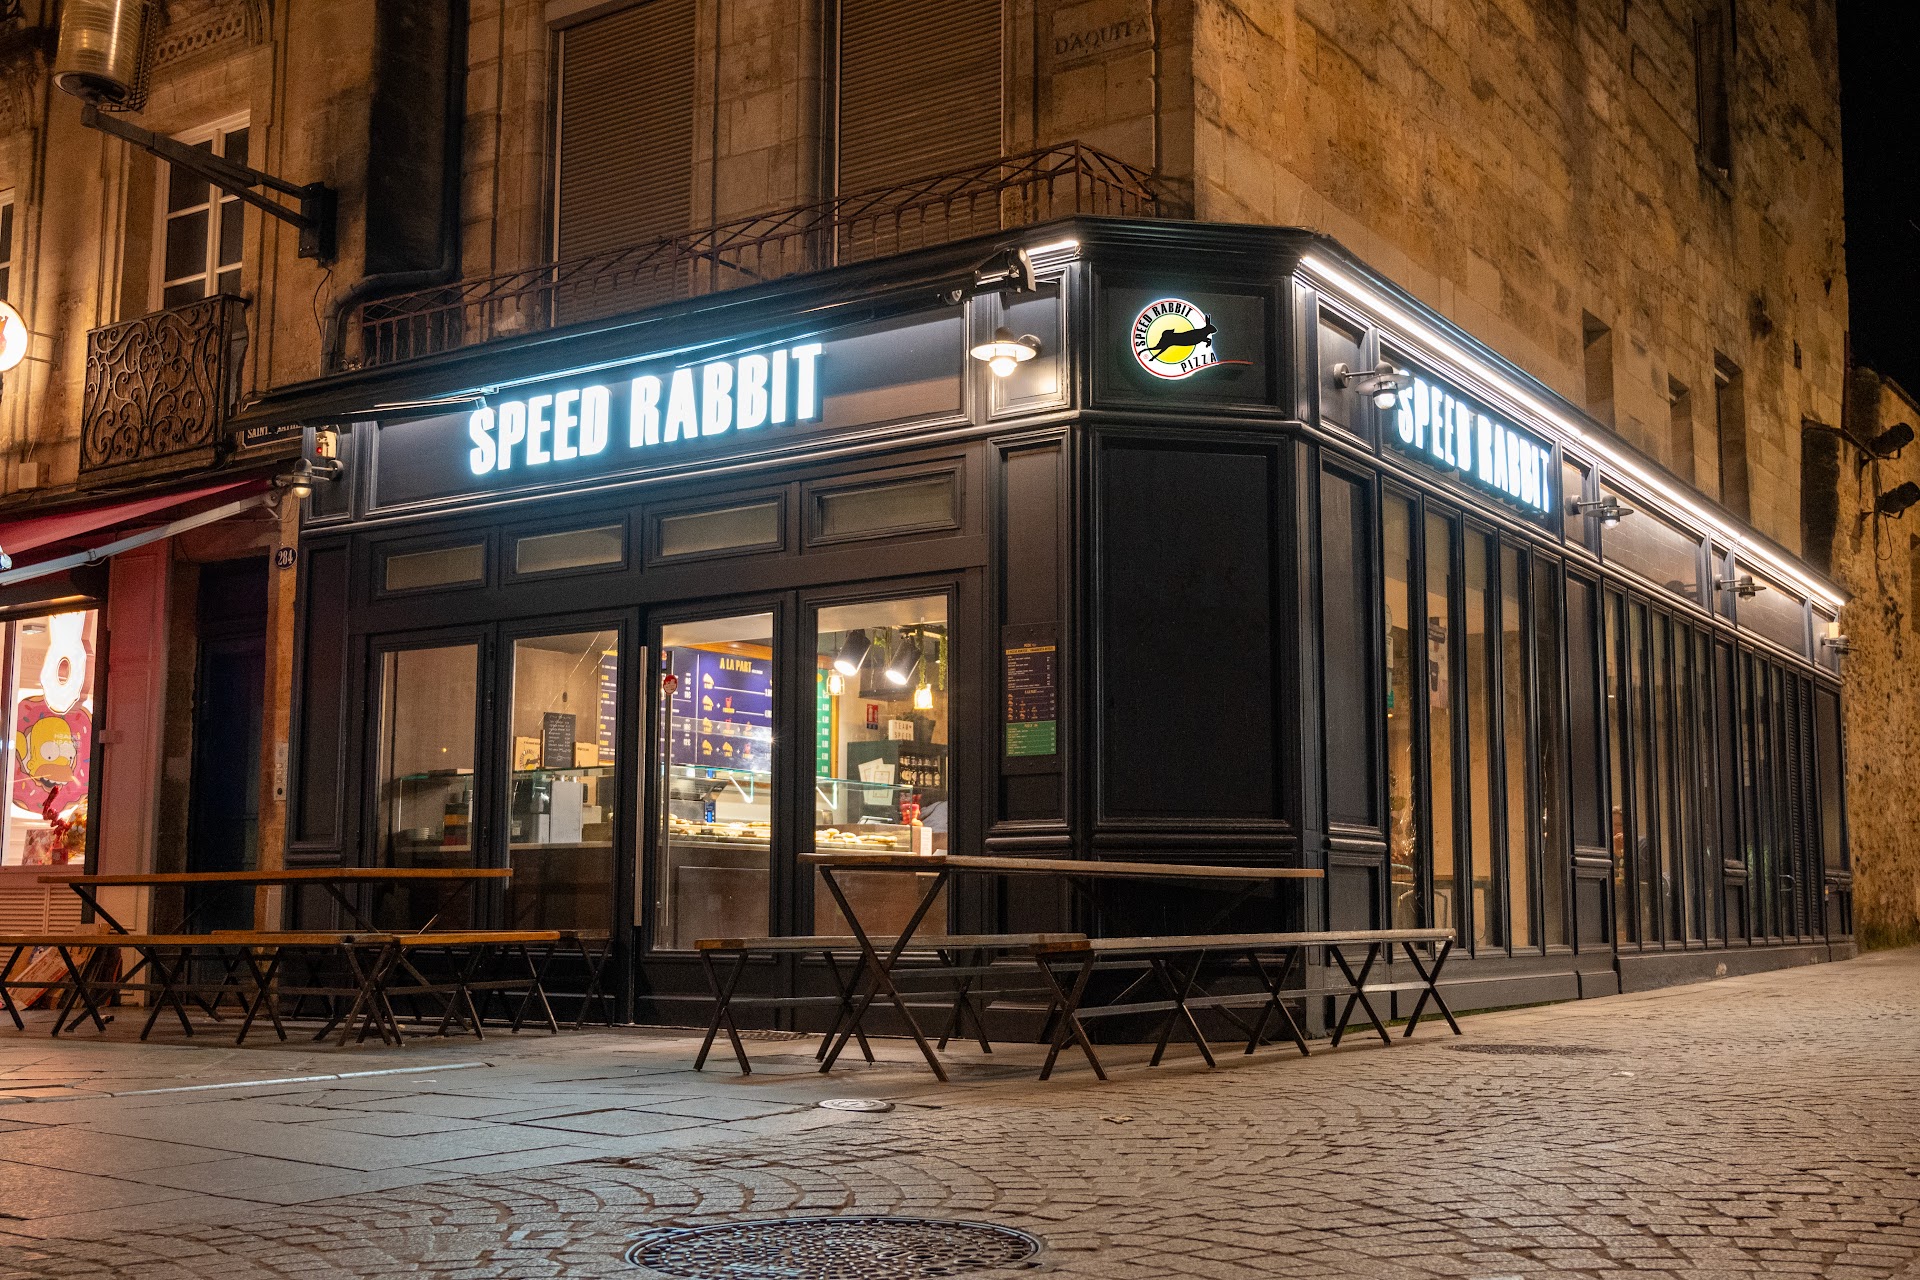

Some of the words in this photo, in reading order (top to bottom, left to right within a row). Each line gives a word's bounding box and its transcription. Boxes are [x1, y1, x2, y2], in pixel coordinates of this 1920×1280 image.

[1135, 313, 1153, 347] SPEED
[1152, 302, 1193, 317] RABBIT
[1181, 352, 1217, 372] PIZZA
[468, 384, 609, 476] SPEED
[629, 342, 823, 448] RABBIT
[1397, 369, 1472, 472] SPEED
[1477, 413, 1551, 513] RABBIT
[277, 549, 294, 565] 284
[719, 657, 725, 669] A
[726, 658, 735, 671] LA
[735, 659, 752, 673] PART
